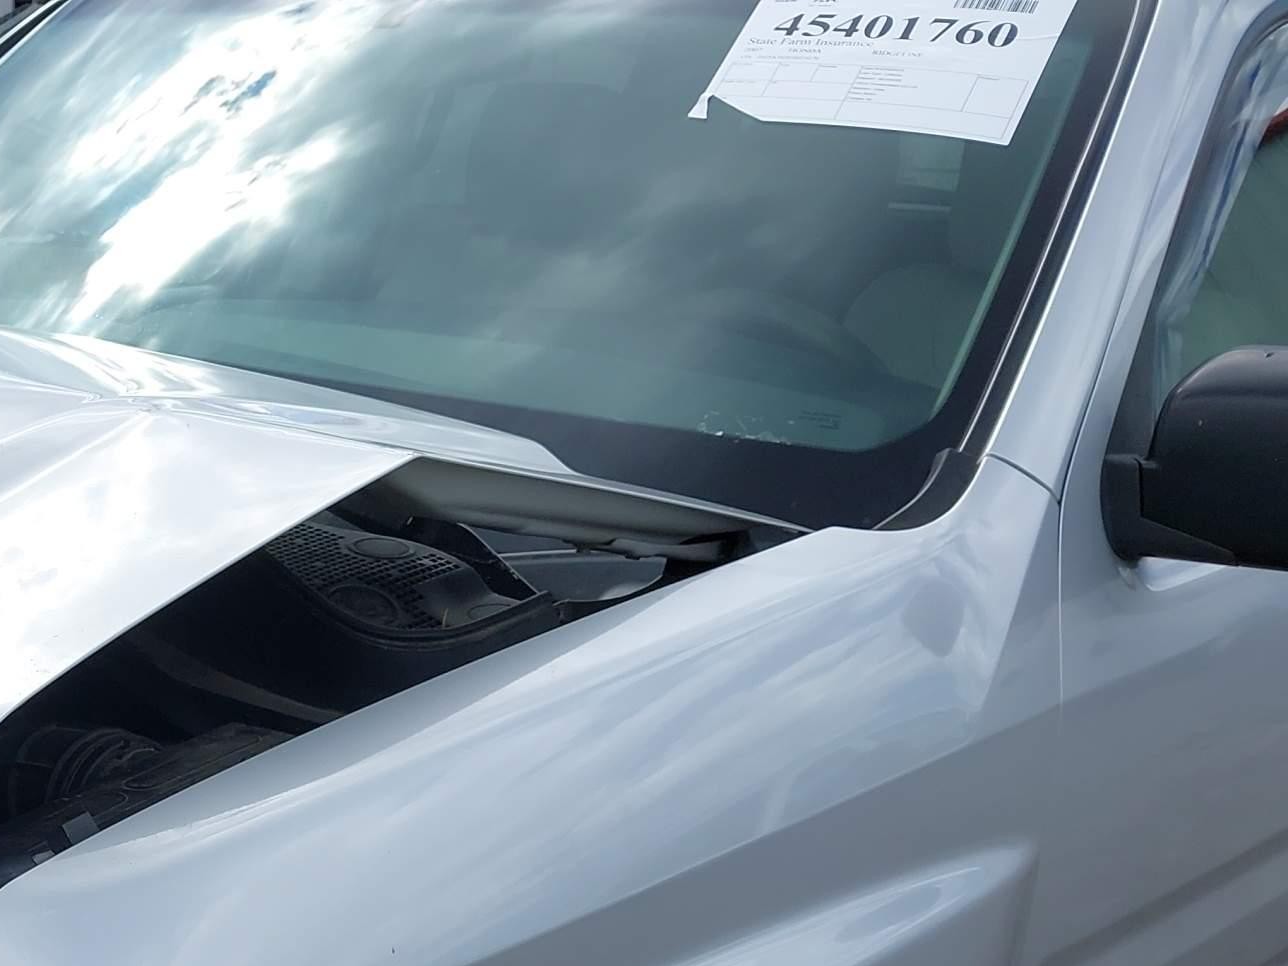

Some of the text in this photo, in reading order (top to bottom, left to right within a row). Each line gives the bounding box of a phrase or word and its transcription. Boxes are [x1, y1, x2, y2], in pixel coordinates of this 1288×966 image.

[774, 13, 1018, 48] 45401760
[747, 38, 874, 48] State Farm Insurance
